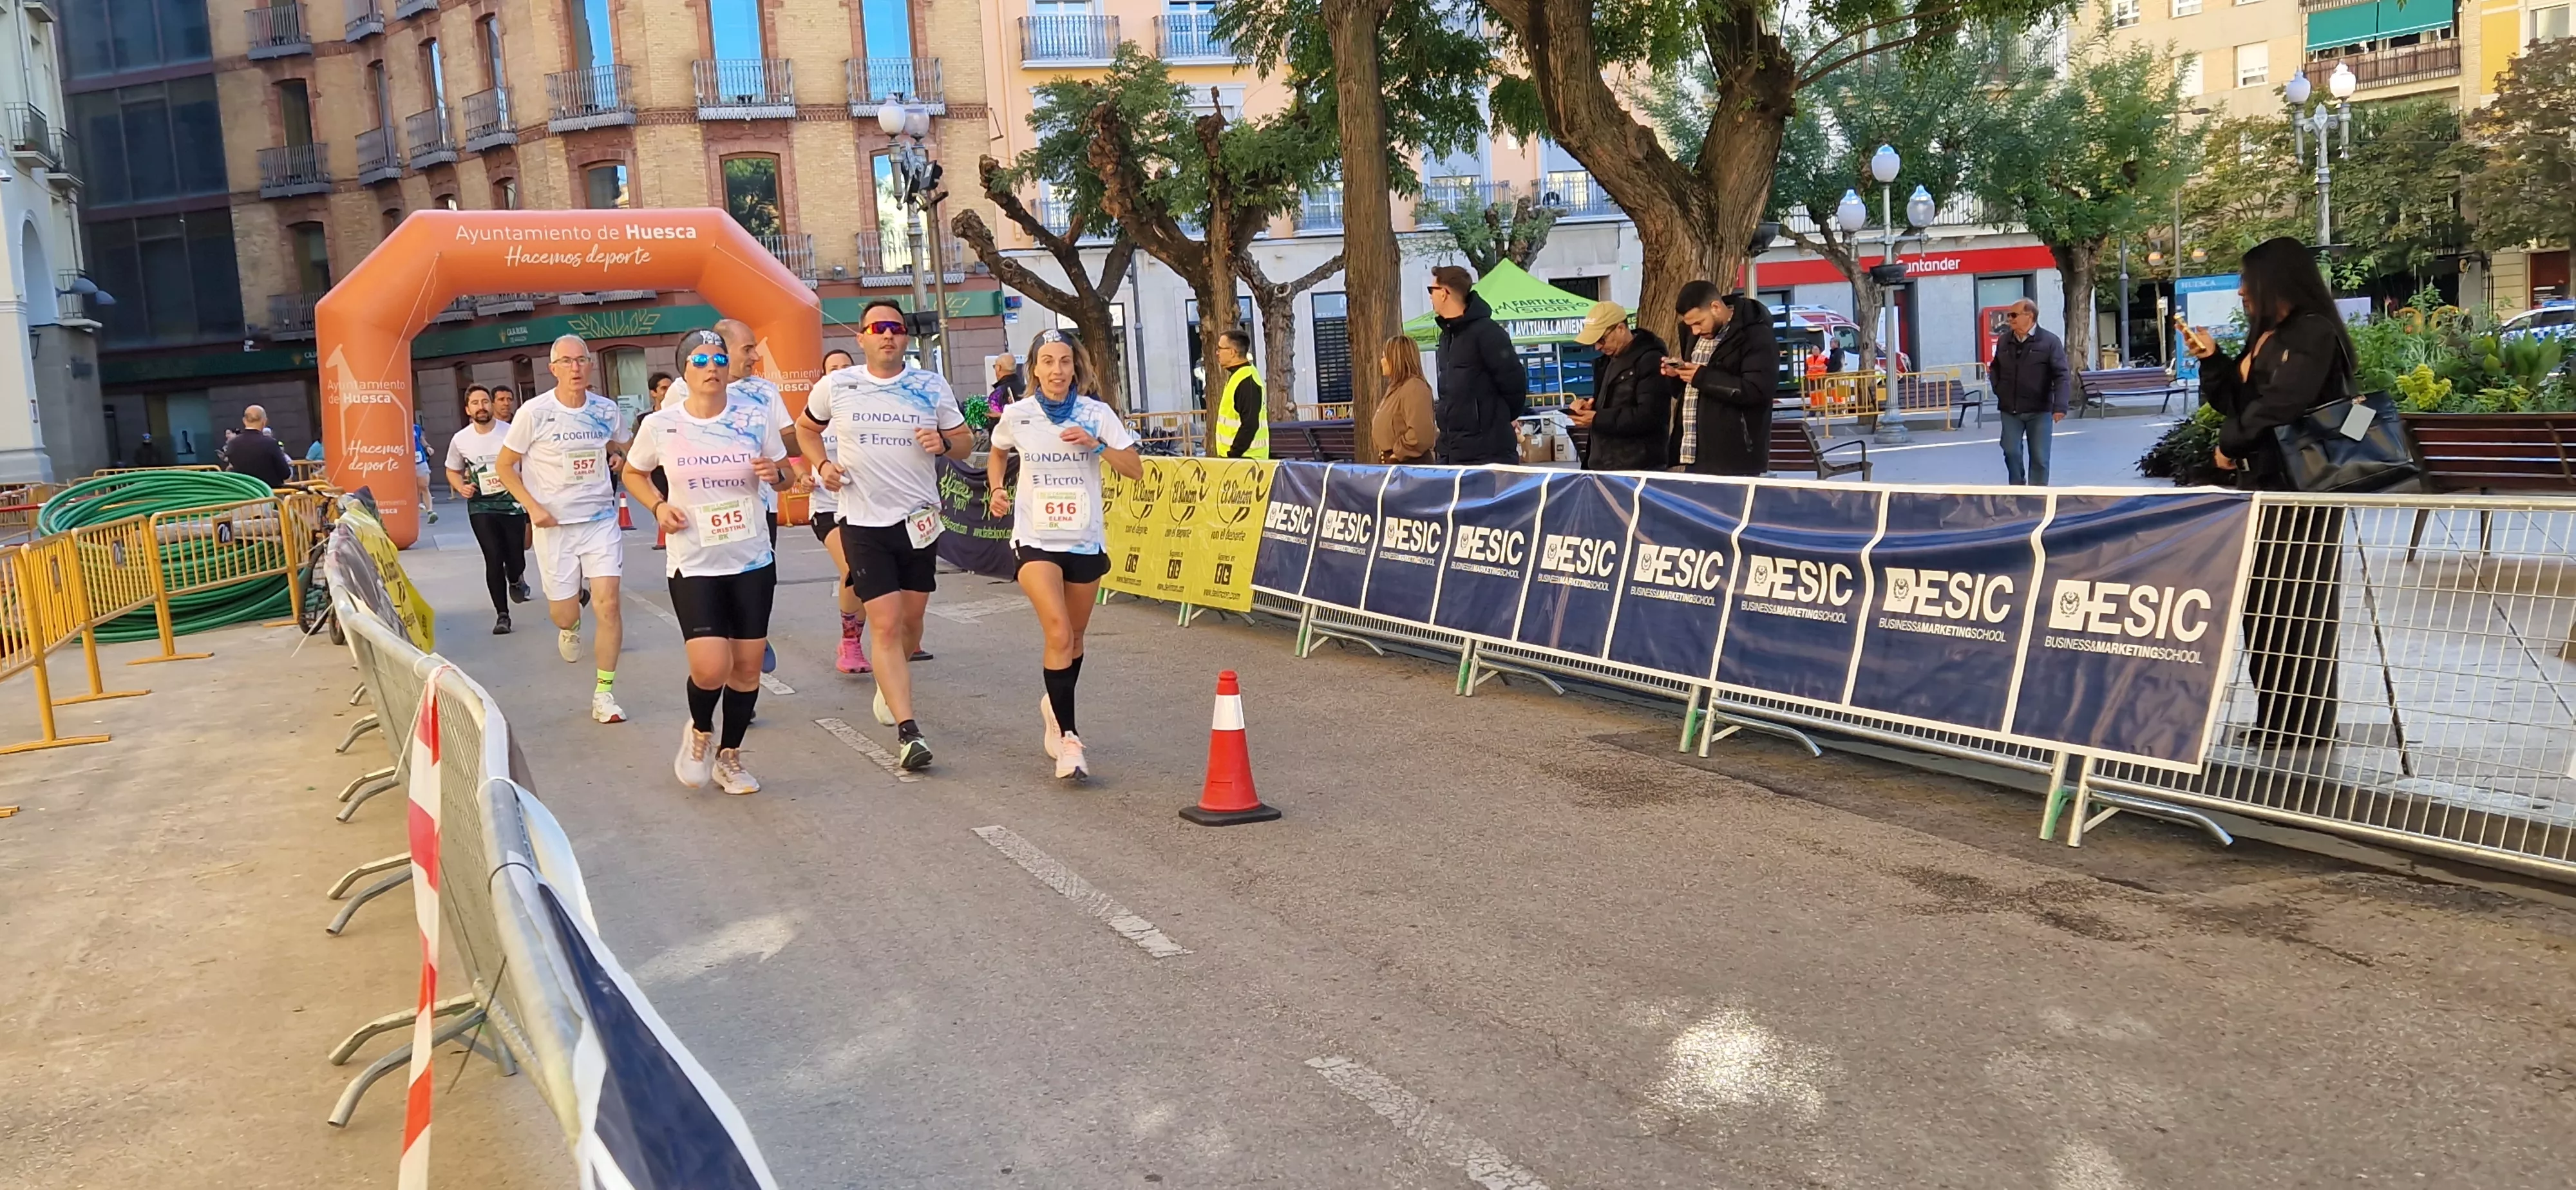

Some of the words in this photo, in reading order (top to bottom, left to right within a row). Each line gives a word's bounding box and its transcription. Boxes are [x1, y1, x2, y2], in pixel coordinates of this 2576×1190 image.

[456, 225, 591, 245] Ayuntamiento
[598, 225, 620, 240] de
[625, 224, 697, 240] Huesca
[504, 245, 582, 268] Hacemos
[585, 243, 652, 272] deporte
[1577, 267, 1582, 276] 2
[1512, 298, 1572, 307] FARTLECK
[1520, 306, 1578, 314] SPORT
[1515, 317, 1585, 336] AVITUALLAMIEN
[327, 379, 406, 393] Ayuntamiento
[328, 393, 340, 404] de
[343, 392, 392, 404] Huesca
[852, 412, 920, 424] BONDALTI
[347, 439, 404, 457] Hacemos
[871, 433, 913, 447] Ercros
[573, 458, 596, 470] 557
[677, 453, 751, 467] BONDALTI
[1024, 451, 1089, 462] BONDALTI
[348, 455, 399, 478] deporte
[701, 477, 746, 489] Ercros
[1043, 474, 1084, 486] Ercros
[1045, 502, 1077, 515] 616
[711, 510, 743, 527] 615
[1275, 502, 1313, 534] ESIC
[1332, 510, 1372, 544] ESIC
[711, 524, 746, 534] CRISTINA
[1396, 518, 1441, 554] ESIC
[1470, 526, 1525, 566] ESIC
[1558, 536, 1616, 577] ESIC
[1655, 546, 1724, 590] ESIC
[1772, 556, 1853, 607] ESIC
[1914, 569, 2014, 624] ESIC
[2087, 581, 2211, 643] ESIC
[1879, 617, 2007, 643] BUSINESS&MARKETINGSCHOOL
[2044, 635, 2203, 665] BUSINESS&MARKETINGSCHOOL
